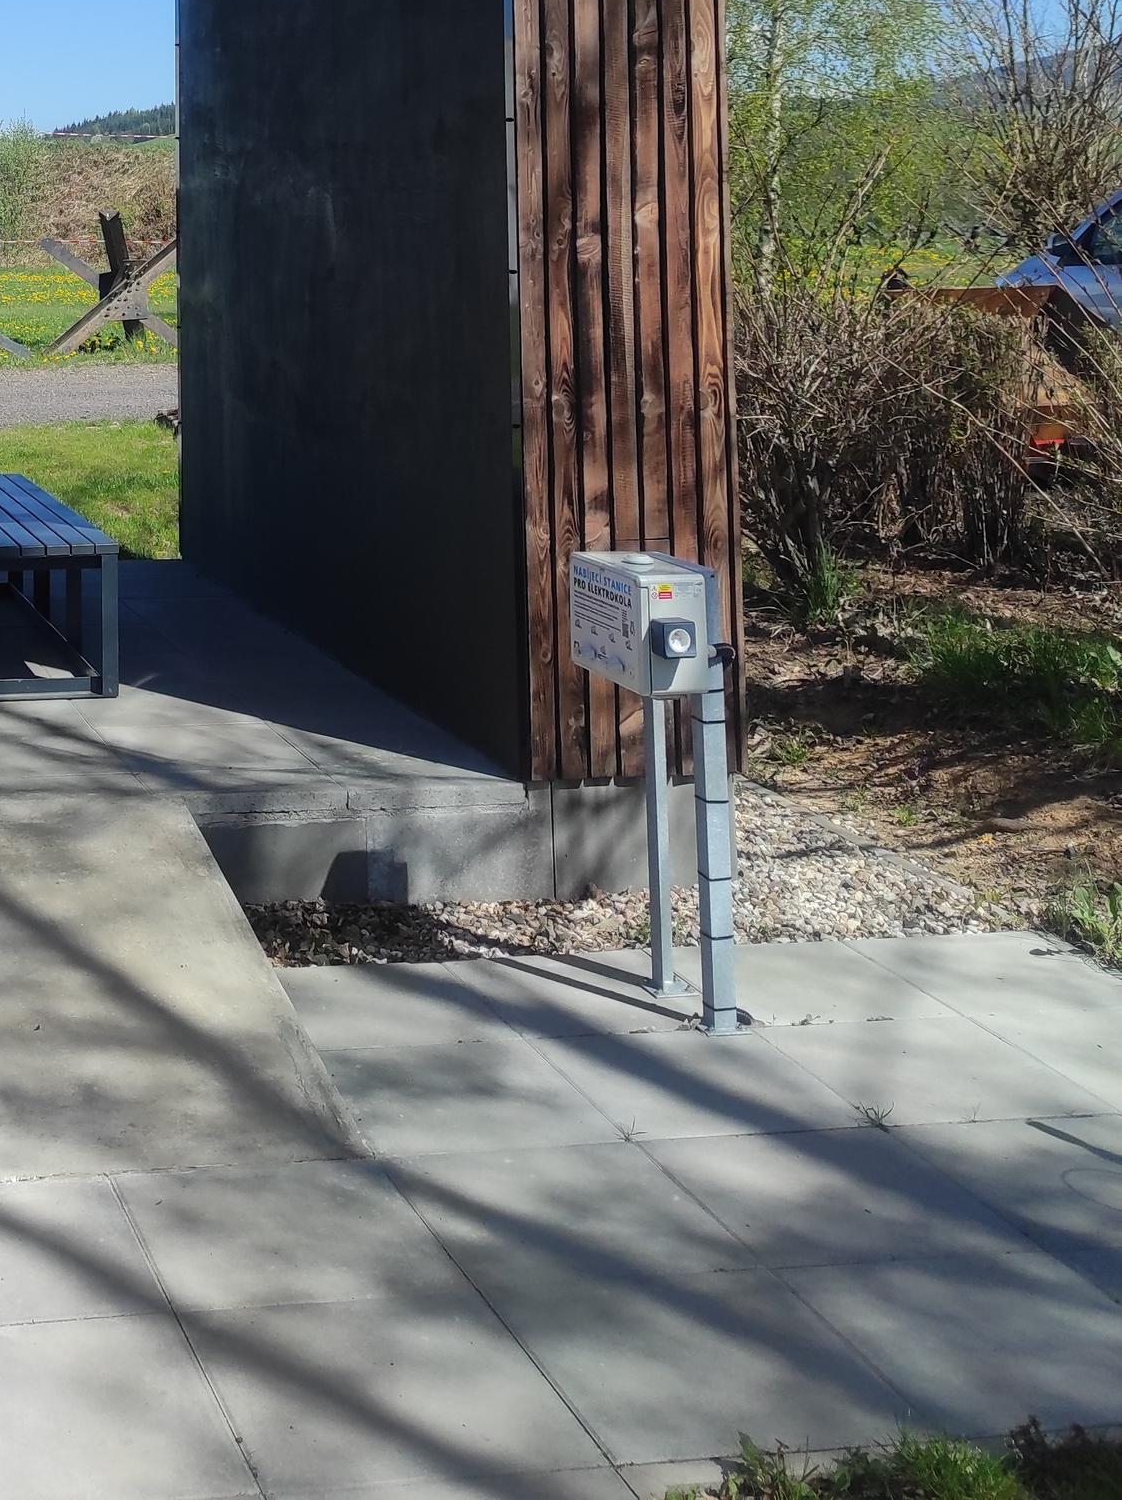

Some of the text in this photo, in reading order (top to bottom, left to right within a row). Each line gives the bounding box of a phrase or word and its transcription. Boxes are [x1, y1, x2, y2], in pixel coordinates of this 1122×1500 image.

[573, 577, 586, 590] PRO
[588, 582, 632, 609] ELEKTROKOLA
[603, 576, 632, 596] STANICE
